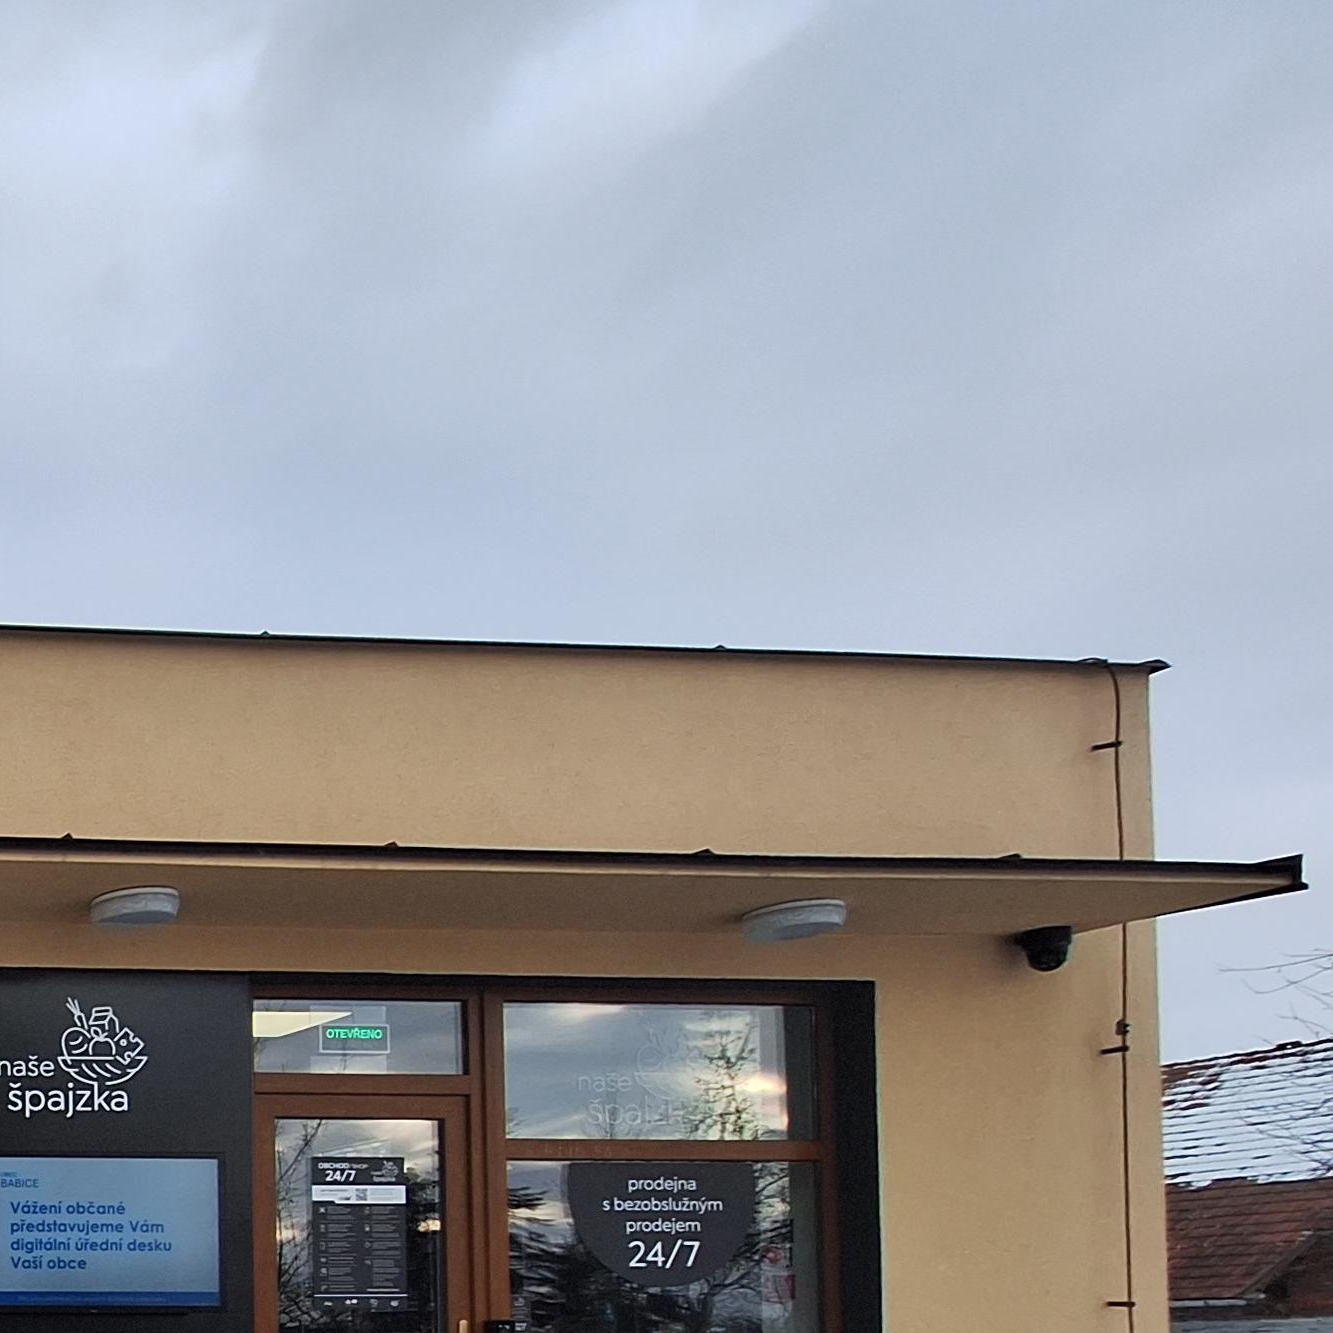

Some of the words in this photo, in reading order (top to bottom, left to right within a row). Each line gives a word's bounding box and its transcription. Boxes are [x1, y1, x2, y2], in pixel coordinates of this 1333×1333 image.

[325, 1027, 383, 1039] OTEVŘENO
[7, 1083, 129, 1118] špajzka
[0, 1178, 39, 1188] BABICE
[325, 1169, 357, 1182] 24/7
[627, 1176, 697, 1193] prodejna
[10, 1200, 62, 1215] Vážení
[66, 1201, 126, 1215] občané
[602, 1200, 611, 1211] s
[614, 1195, 723, 1214] bezobslužným
[10, 1219, 124, 1236] představujeme
[129, 1219, 165, 1233] Vám
[625, 1218, 701, 1235] prodejem
[10, 1237, 71, 1254] digitální
[75, 1237, 123, 1251] úřední
[127, 1238, 172, 1252] desku
[628, 1239, 701, 1269] 24/7
[10, 1255, 43, 1269] Vaší
[46, 1256, 88, 1270] obce
